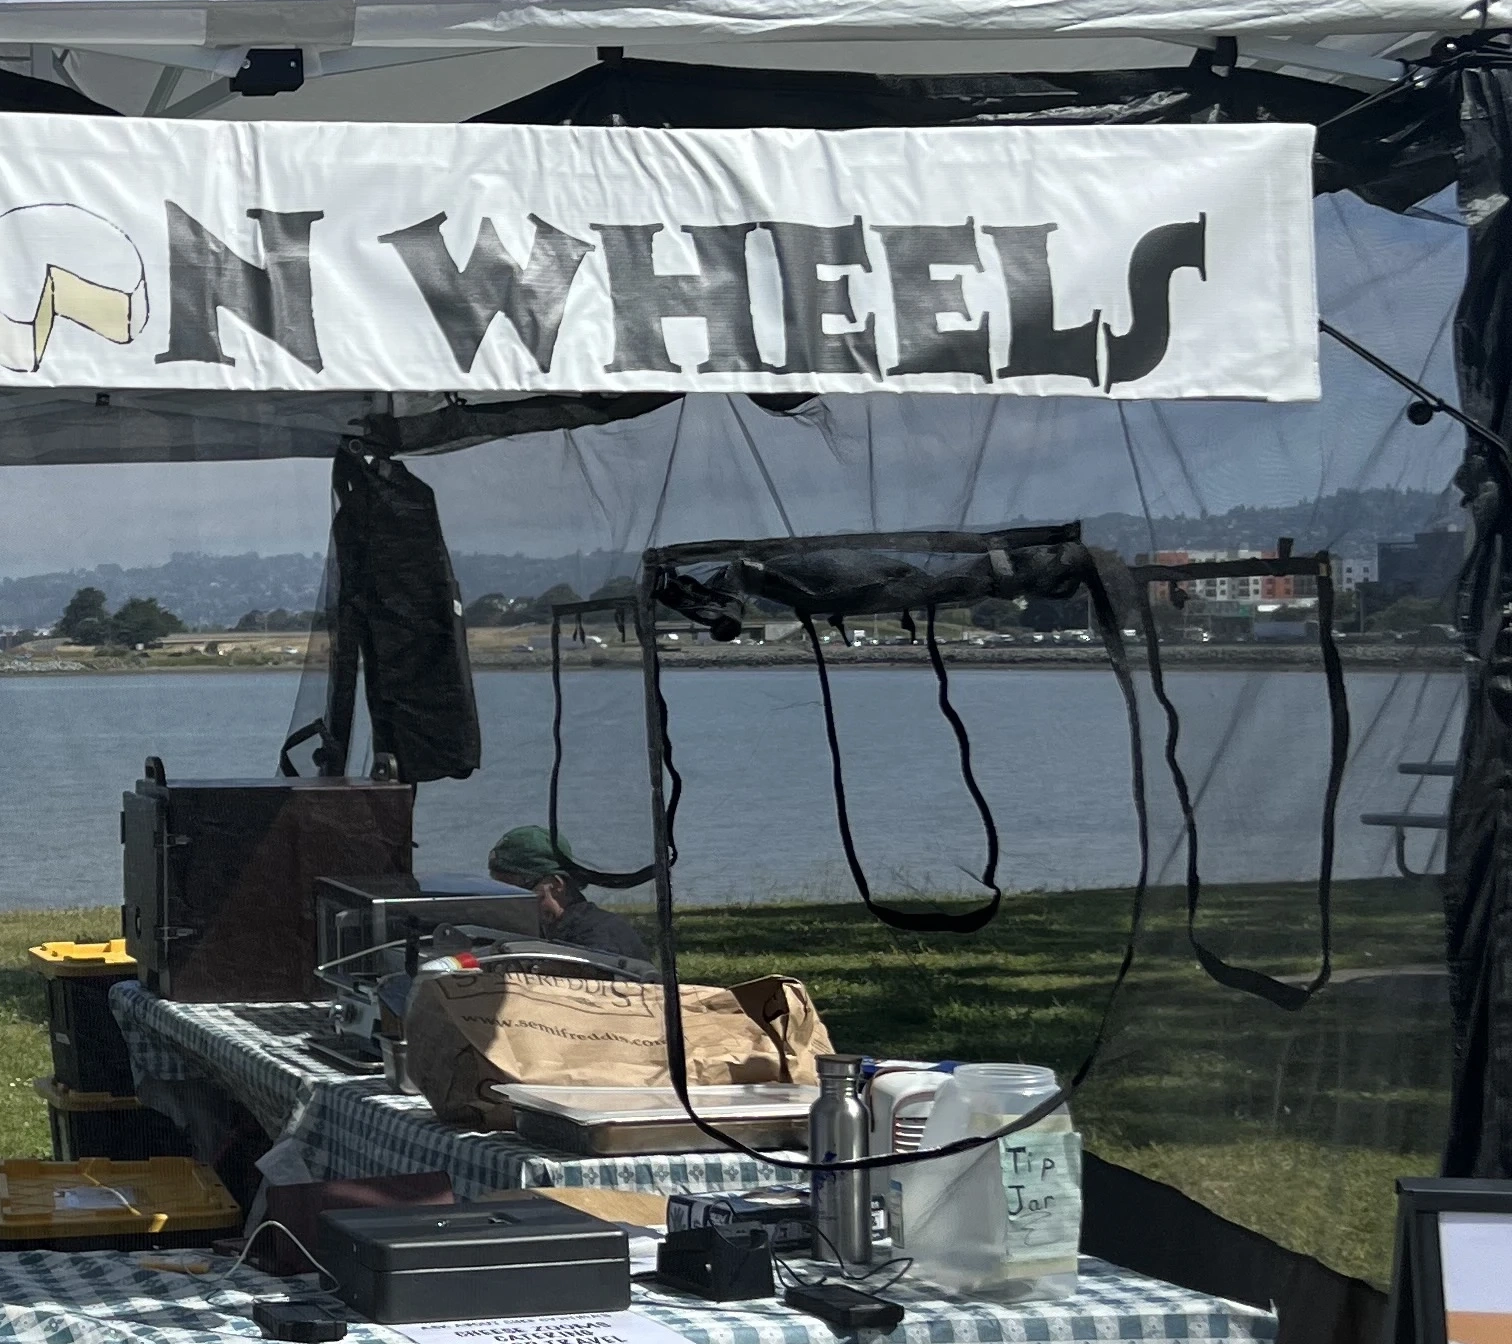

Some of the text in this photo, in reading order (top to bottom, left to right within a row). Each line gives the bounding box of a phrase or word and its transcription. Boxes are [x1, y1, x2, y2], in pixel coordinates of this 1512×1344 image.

[377, 211, 1207, 394] WHEELS
[1006, 1147, 1055, 1181] Tip
[1008, 1185, 1055, 1216] Jar
[455, 1322, 611, 1337] CHEESE ZOOMS
[494, 1329, 594, 1342] CATERING
